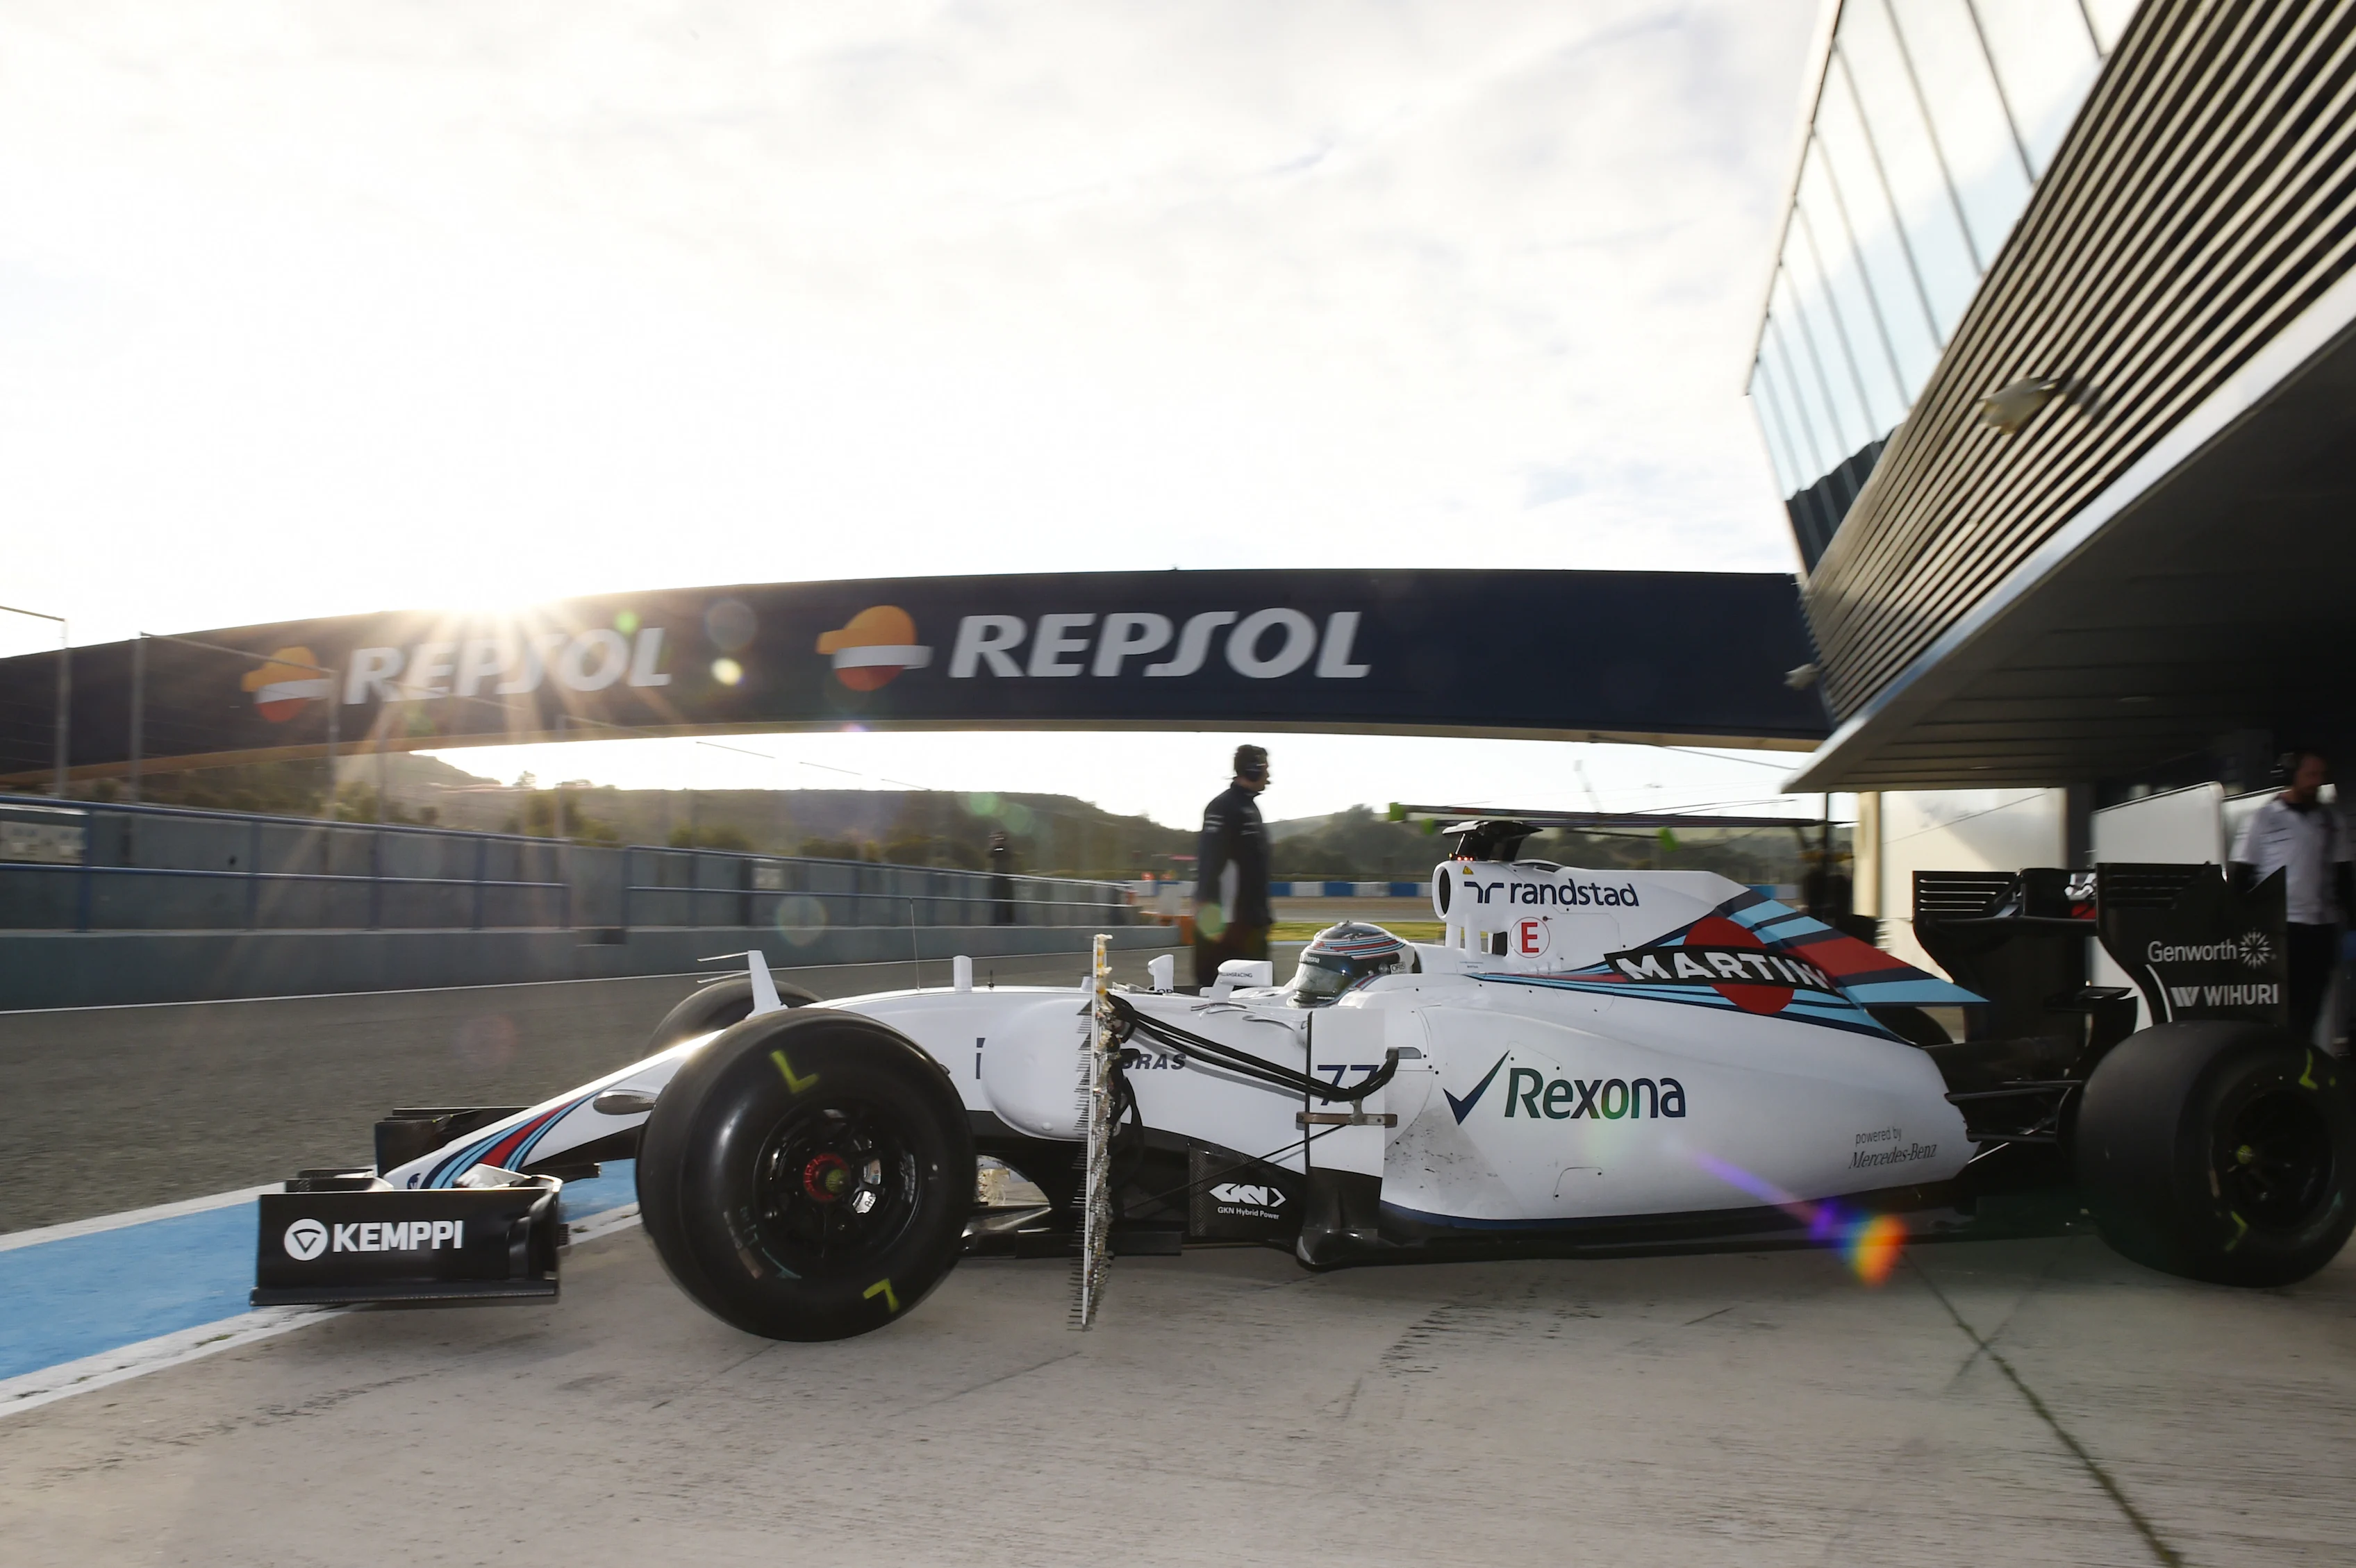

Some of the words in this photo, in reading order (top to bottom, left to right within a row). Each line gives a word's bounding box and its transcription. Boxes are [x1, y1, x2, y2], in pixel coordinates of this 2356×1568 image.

[948, 607, 1371, 678] REPSOL
[343, 627, 672, 705] REPSOL
[1510, 878, 1639, 907] randstad
[1520, 922, 1539, 953] E
[2148, 939, 2237, 962] Genworth
[2203, 984, 2279, 1006] WIHURI
[1504, 1067, 1686, 1119] Rexona
[1855, 1127, 1891, 1146] powered
[1893, 1126, 1902, 1141] by
[1848, 1142, 1937, 1169] Mercedes-Benz
[1236, 1208, 1259, 1217] Hybrid
[1259, 1210, 1279, 1219] Power
[333, 1220, 464, 1252] KEMPPI
